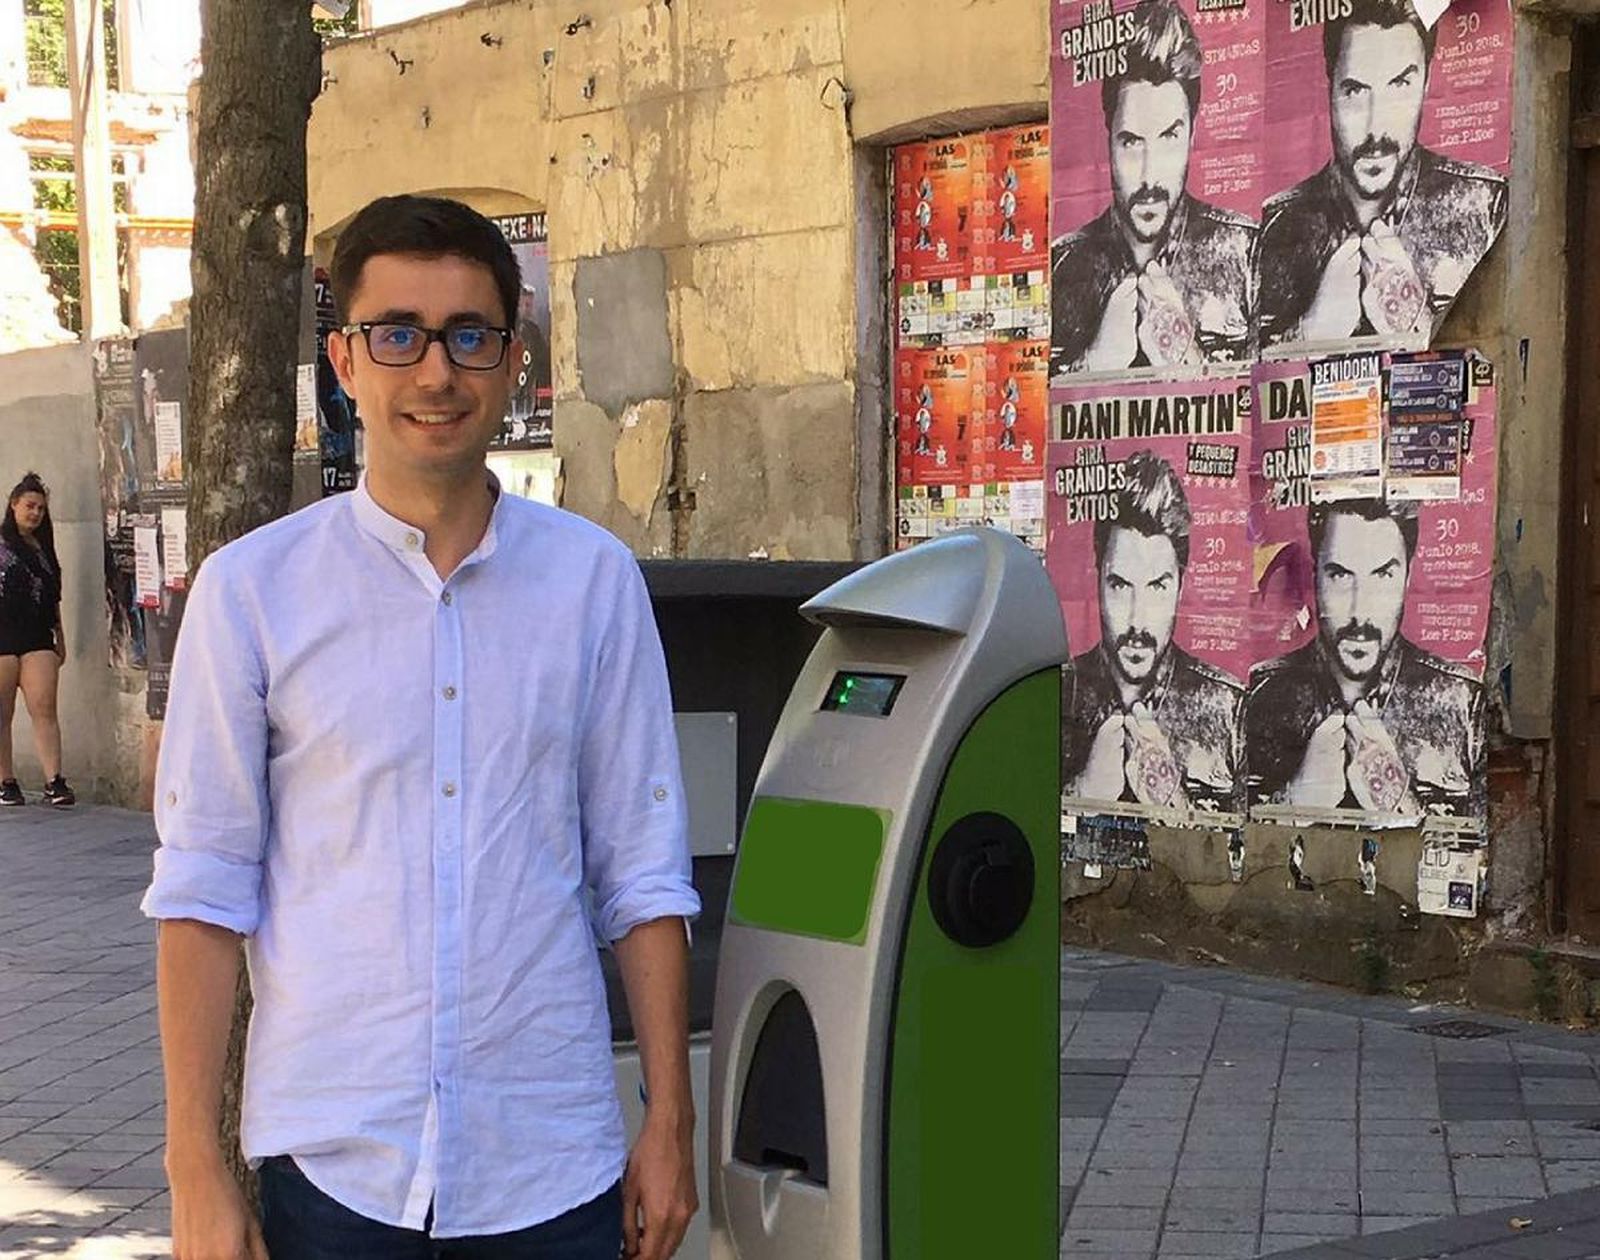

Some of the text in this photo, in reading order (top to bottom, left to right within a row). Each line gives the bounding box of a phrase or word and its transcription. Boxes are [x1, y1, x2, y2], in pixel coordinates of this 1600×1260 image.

[1083, 0, 1112, 24] GIRA
[1061, 12, 1136, 59] GRANDES
[1456, 12, 1480, 38] 30
[1216, 72, 1237, 97] 30
[1022, 130, 1041, 145] LAS
[936, 143, 955, 157] LAS
[936, 354, 956, 366] LAS
[1022, 346, 1043, 358] LAS
[1314, 356, 1379, 384] BENIDORM
[1061, 388, 1235, 440] DANI MARTÍN
[1076, 446, 1105, 465] GIRA
[1055, 463, 1126, 496] GRANDES
[1436, 518, 1459, 541] 30
[1204, 536, 1226, 558] 30
